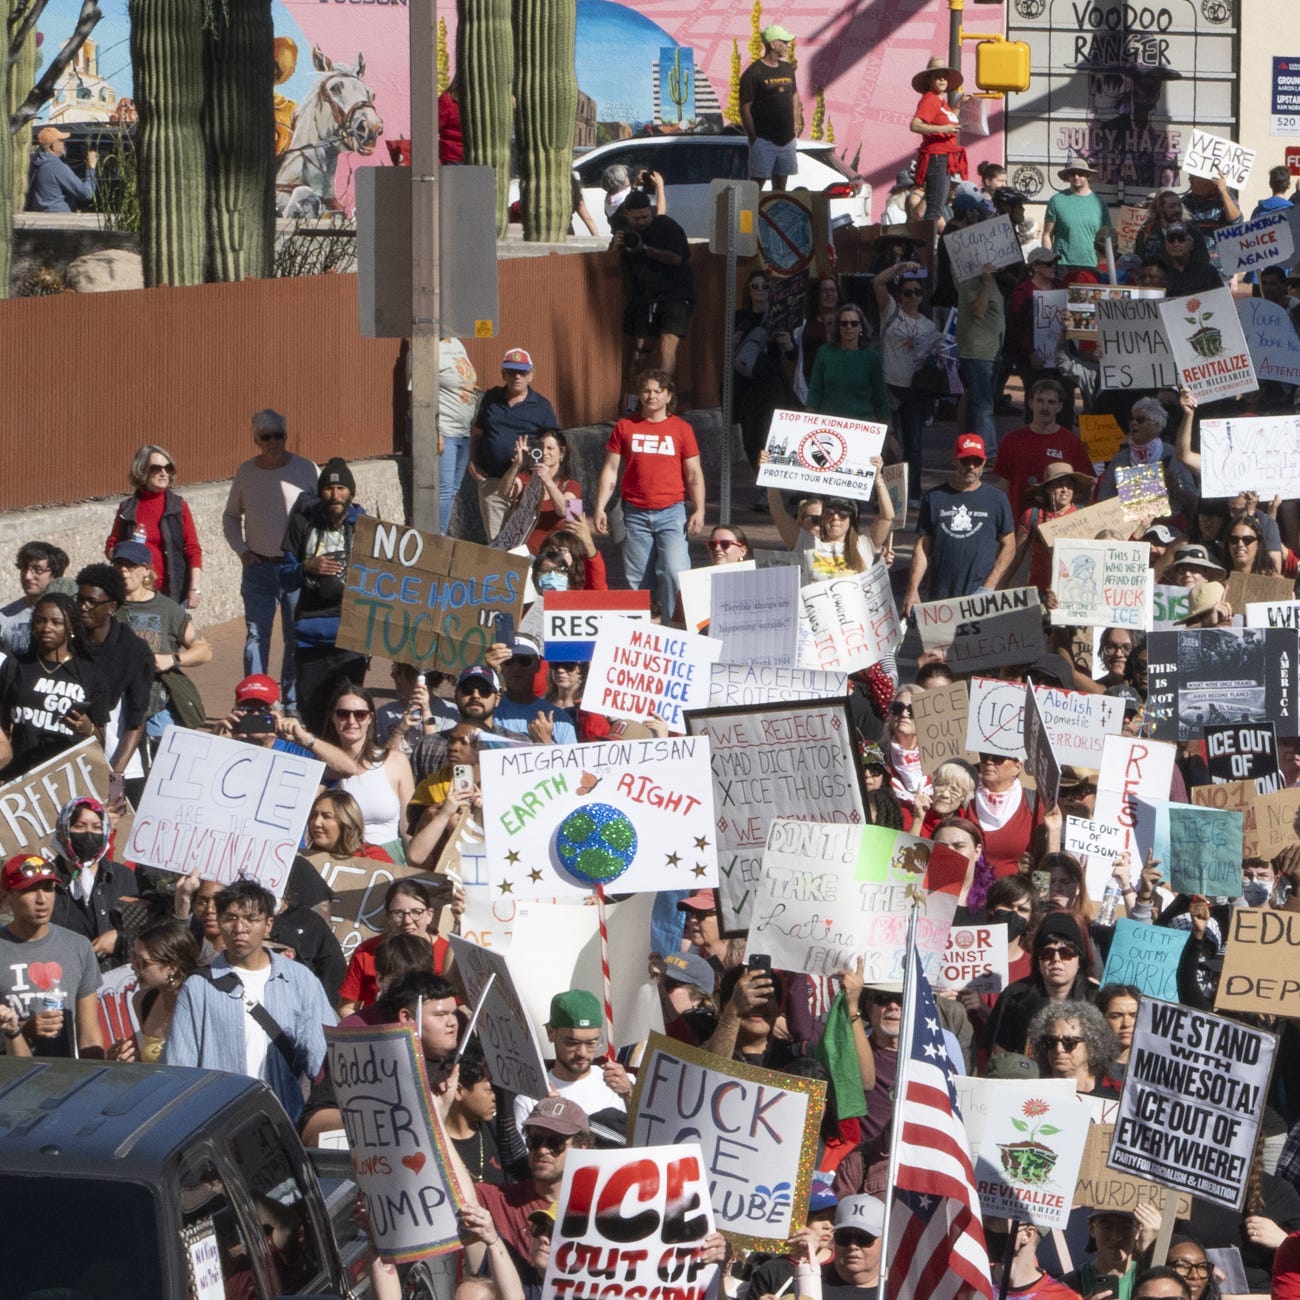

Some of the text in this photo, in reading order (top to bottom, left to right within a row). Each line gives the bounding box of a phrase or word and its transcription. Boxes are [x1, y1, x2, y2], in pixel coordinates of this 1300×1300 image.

[1072, 1, 1173, 32] VOODOO
[1074, 35, 1171, 66] RANGER
[1126, 129, 1181, 154] HAZE
[1245, 214, 1287, 233] AMERICA
[1237, 247, 1279, 268] AGAIN
[1183, 354, 1248, 383] REVITALIZE
[630, 630, 687, 658] MALICE
[613, 647, 695, 681] INJUSTICE
[607, 667, 690, 702] COWARDICE
